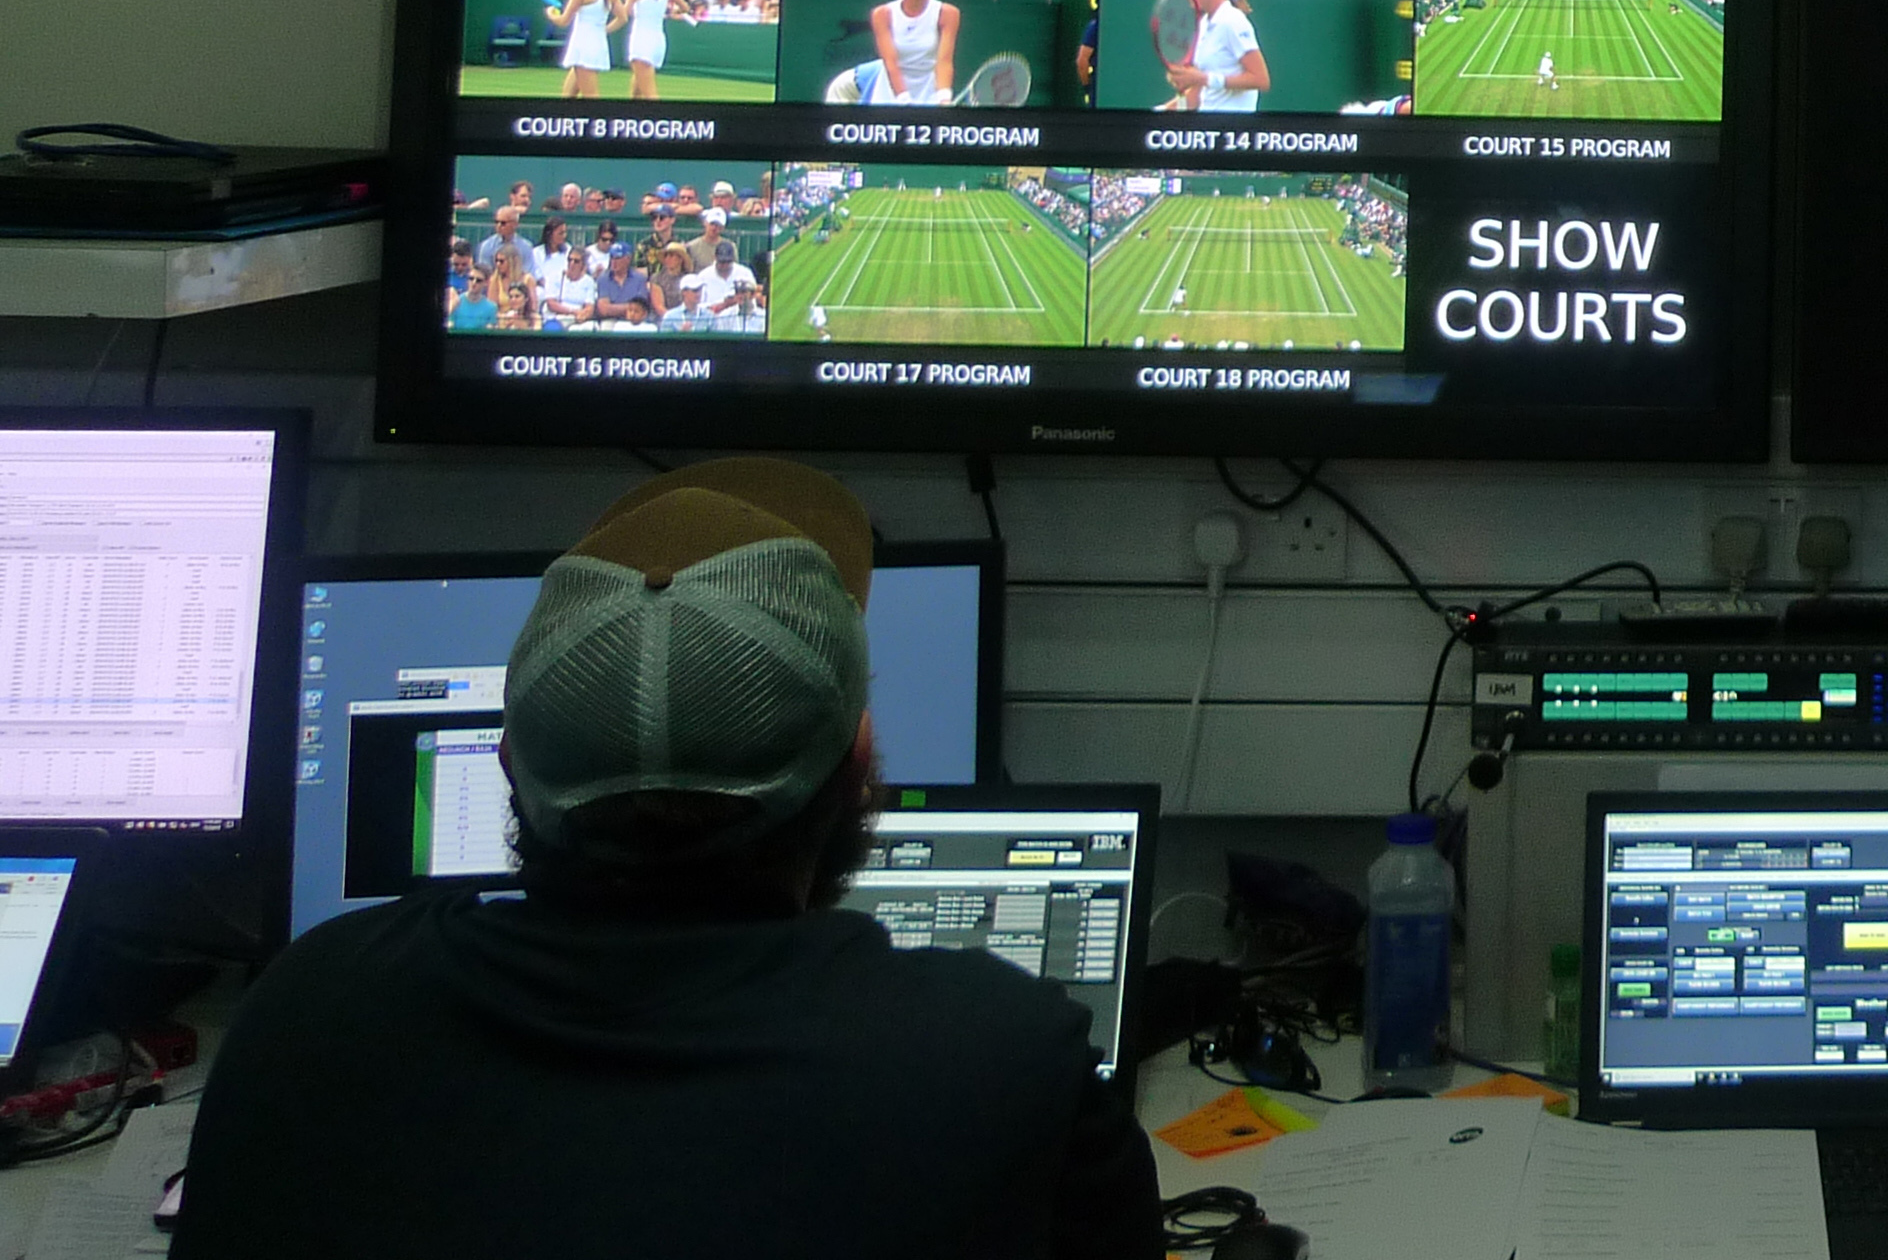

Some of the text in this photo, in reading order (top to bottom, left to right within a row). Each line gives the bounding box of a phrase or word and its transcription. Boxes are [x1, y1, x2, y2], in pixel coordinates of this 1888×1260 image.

[515, 116, 715, 140] COURT 8 PROGRAM
[827, 123, 1040, 147] COURT 12 PROGRAM
[1145, 130, 1358, 152] COURT 14 PROGRAM
[1463, 136, 1671, 159] COURT 15 PROGRAM
[1468, 218, 1660, 271] SHOW
[1435, 289, 1687, 344] COURTS
[497, 355, 711, 379] COURT 16 PROGRAM
[817, 361, 1031, 385] COURT 17 PROGRAM
[1137, 367, 1351, 389] COURT 18 PROGRAM
[1031, 425, 1116, 441] Panasonic
[1090, 834, 1126, 849] IBM
